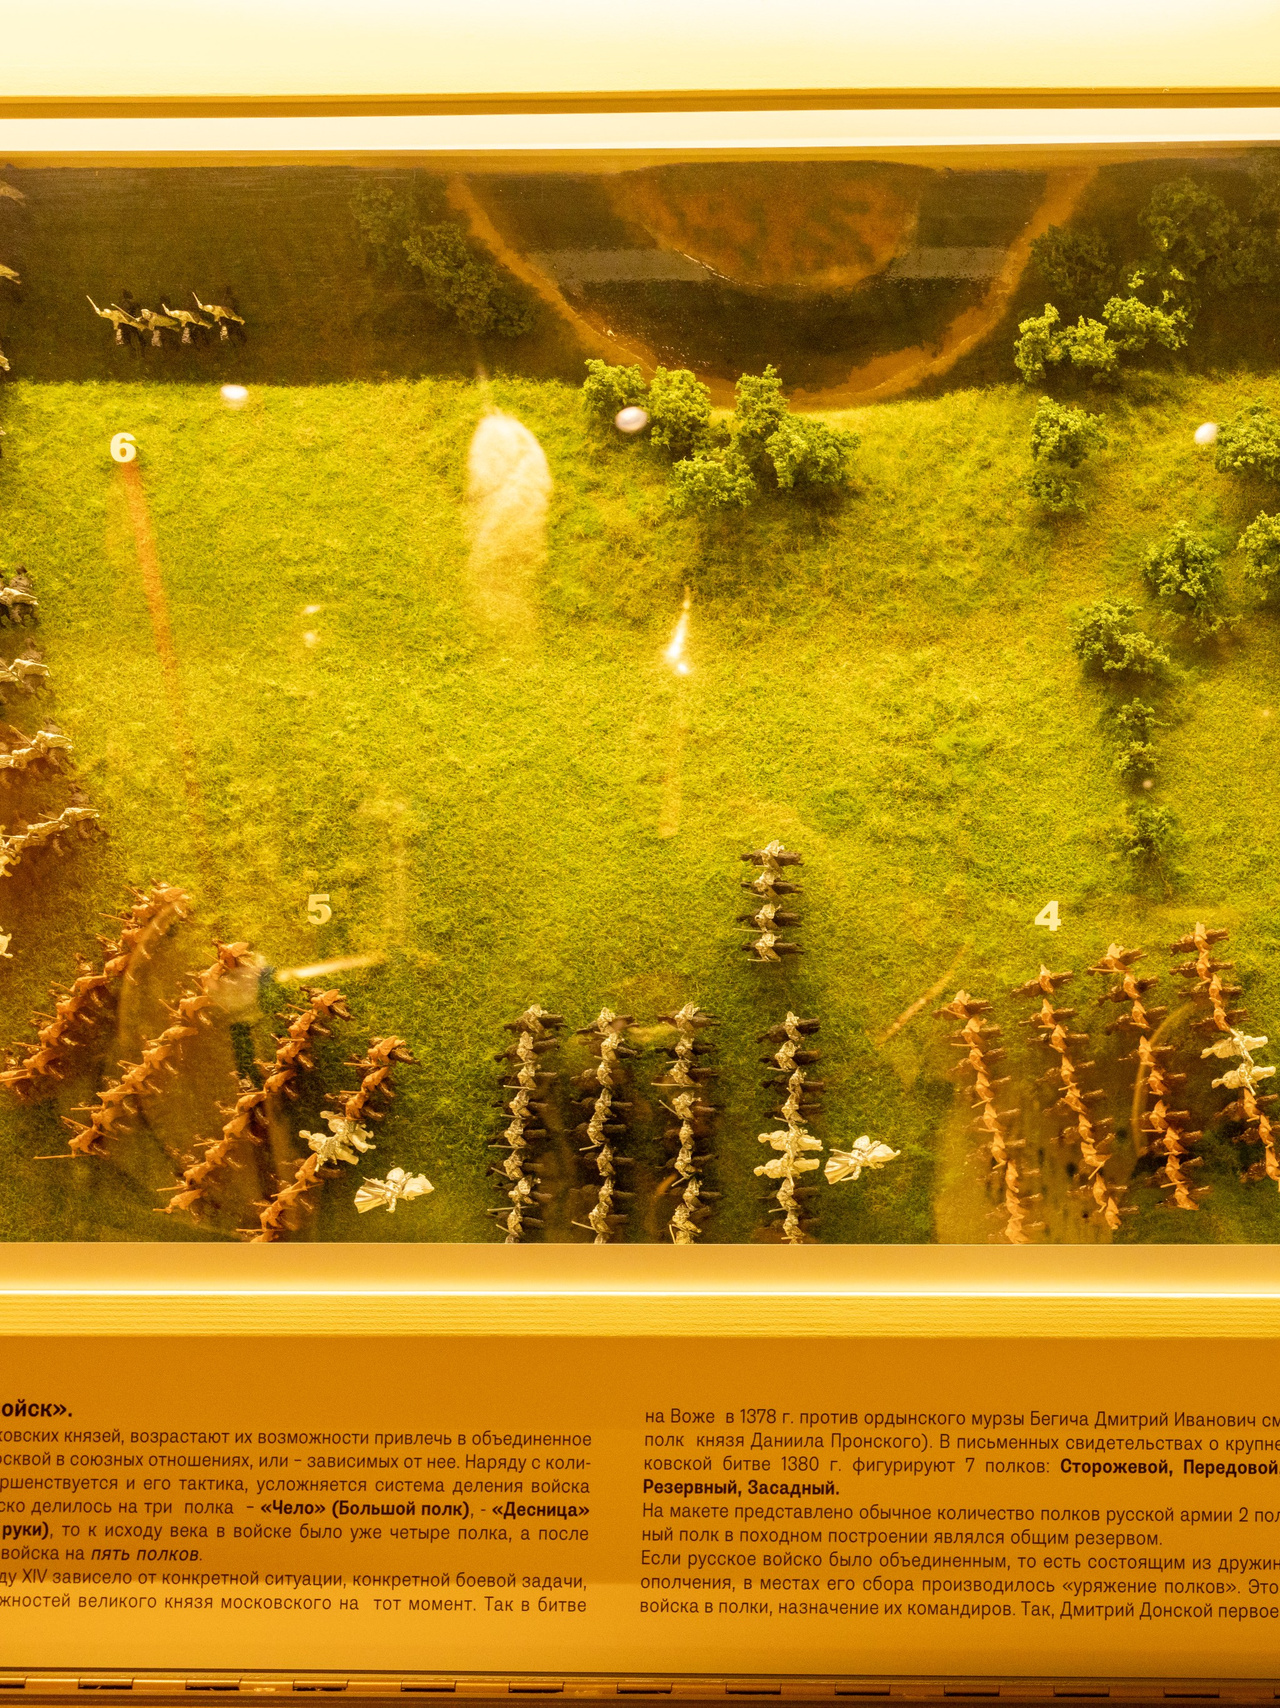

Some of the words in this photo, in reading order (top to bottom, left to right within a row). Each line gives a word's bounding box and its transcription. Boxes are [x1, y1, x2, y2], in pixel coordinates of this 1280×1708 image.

[110, 432, 136, 463] 6
[307, 894, 332, 925] 5
[1034, 901, 1061, 931] 4
[644, 1434, 685, 1448] полк
[696, 1434, 745, 1448] князя
[749, 1431, 825, 1451] Даниила
[830, 1431, 933, 1454] Пронского).
[939, 1432, 951, 1450] В
[956, 1436, 1060, 1451] письменных
[1064, 1437, 1203, 1454] свидетельствах
[1208, 1438, 1220, 1452] о
[643, 1455, 713, 1472] ковской
[722, 1454, 772, 1472] битве
[780, 1455, 820, 1473] 1380
[829, 1459, 843, 1472] г.
[851, 1456, 957, 1478] фигурируют
[964, 1456, 976, 1474] 7
[984, 1460, 1050, 1474] полков:
[1059, 1457, 1174, 1479] Сторожевой,
[125, 1478, 136, 1491] и
[142, 1477, 172, 1491] его
[178, 1478, 249, 1494] тактика,
[255, 1478, 368, 1496] усложняется
[374, 1479, 446, 1494] система
[451, 1480, 524, 1497] деления
[530, 1478, 591, 1495] войска
[642, 1477, 743, 1499] Резервный,
[746, 1478, 841, 1499] Засадный.
[641, 1526, 674, 1542] ный
[678, 1529, 720, 1543] полк
[724, 1529, 735, 1543] в
[739, 1529, 823, 1546] походном
[827, 1530, 929, 1548] построении
[933, 1531, 1005, 1545] являлся
[1009, 1528, 1070, 1549] общим
[1074, 1532, 1163, 1550] резервом.
[0, 1544, 60, 1561] войска
[64, 1548, 86, 1561] на
[90, 1548, 131, 1562] пять
[135, 1548, 203, 1563] полков.
[640, 1548, 682, 1566] Если
[687, 1553, 757, 1571] русское
[762, 1551, 823, 1568] войско
[828, 1550, 874, 1568] было
[878, 1550, 1011, 1572] объединенным,
[1016, 1555, 1037, 1570] то
[1042, 1556, 1082, 1570] есть
[1087, 1556, 1186, 1574] состоящим
[1191, 1557, 1213, 1571] из
[21, 1567, 49, 1584] XIV
[52, 1571, 133, 1585] зависело
[137, 1572, 158, 1585] от
[161, 1570, 260, 1589] конкретной
[264, 1573, 347, 1590] ситуации,
[352, 1571, 451, 1591] конкретной
[455, 1570, 517, 1588] боевой
[521, 1575, 587, 1592] задачи,
[640, 1576, 736, 1593] ополчения,
[743, 1577, 753, 1591] в
[759, 1577, 821, 1591] местах
[826, 1578, 856, 1592] его
[862, 1574, 915, 1596] сбора
[921, 1579, 1056, 1596] производилось
[1061, 1580, 1158, 1598] «уряжение
[1164, 1581, 1241, 1595] полков».
[1247, 1577, 1280, 1596] Это
[77, 1595, 158, 1609] великого
[164, 1596, 214, 1610] князя
[220, 1596, 333, 1611] московского
[338, 1597, 360, 1611] на
[372, 1598, 403, 1612] тот
[408, 1598, 477, 1612] момент.
[483, 1595, 514, 1613] Так
[520, 1599, 531, 1613] в
[537, 1595, 587, 1613] битве
